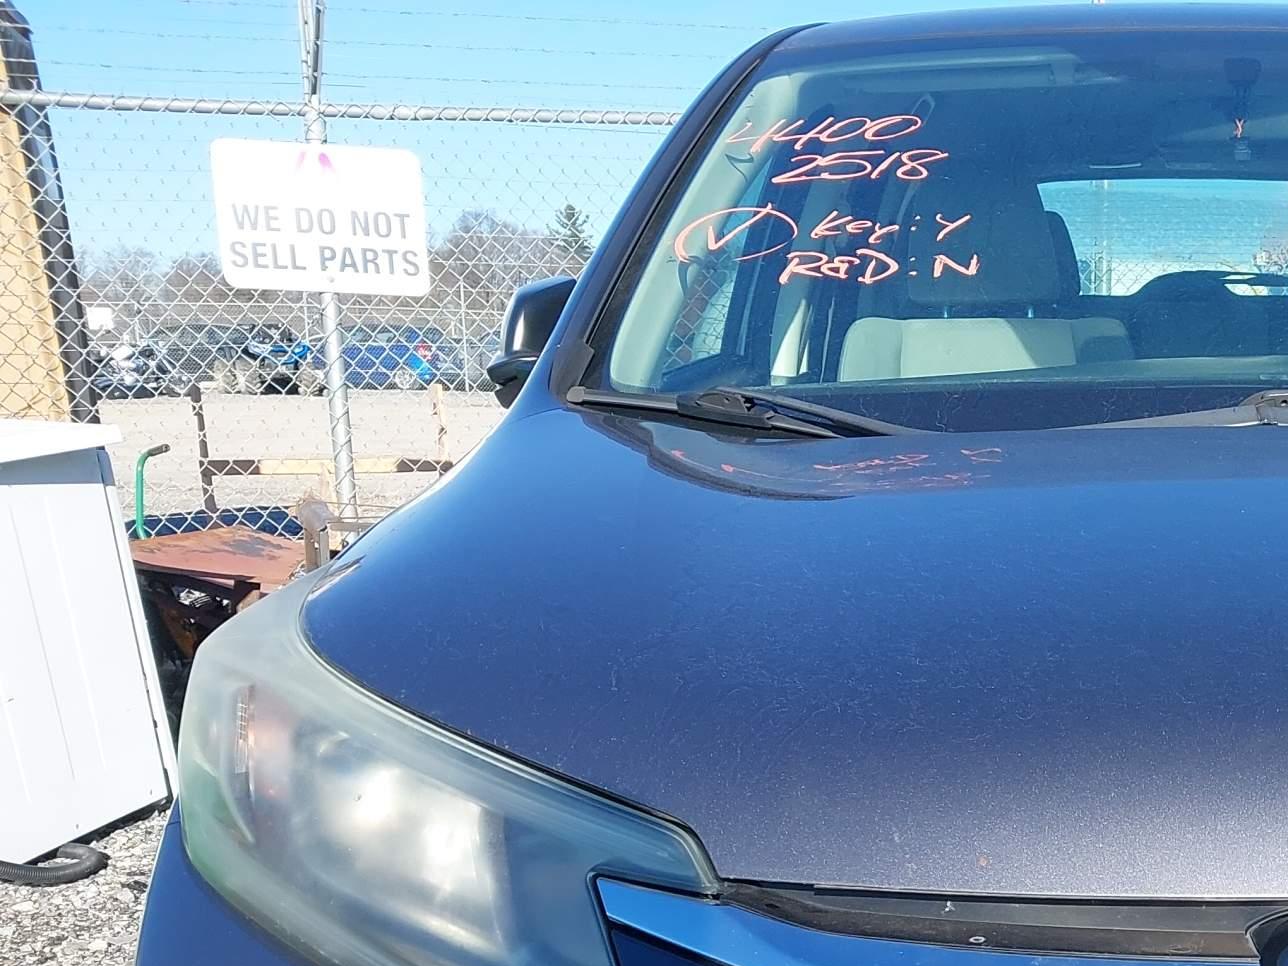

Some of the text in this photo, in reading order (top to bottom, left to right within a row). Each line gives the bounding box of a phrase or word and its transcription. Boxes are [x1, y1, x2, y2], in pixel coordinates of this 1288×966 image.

[725, 115, 922, 152] 4400
[771, 150, 949, 183] 2518
[232, 203, 410, 240] WE DO NOT
[935, 213, 972, 242] Y
[229, 241, 420, 277] SELL PARTS
[933, 253, 980, 279] N
